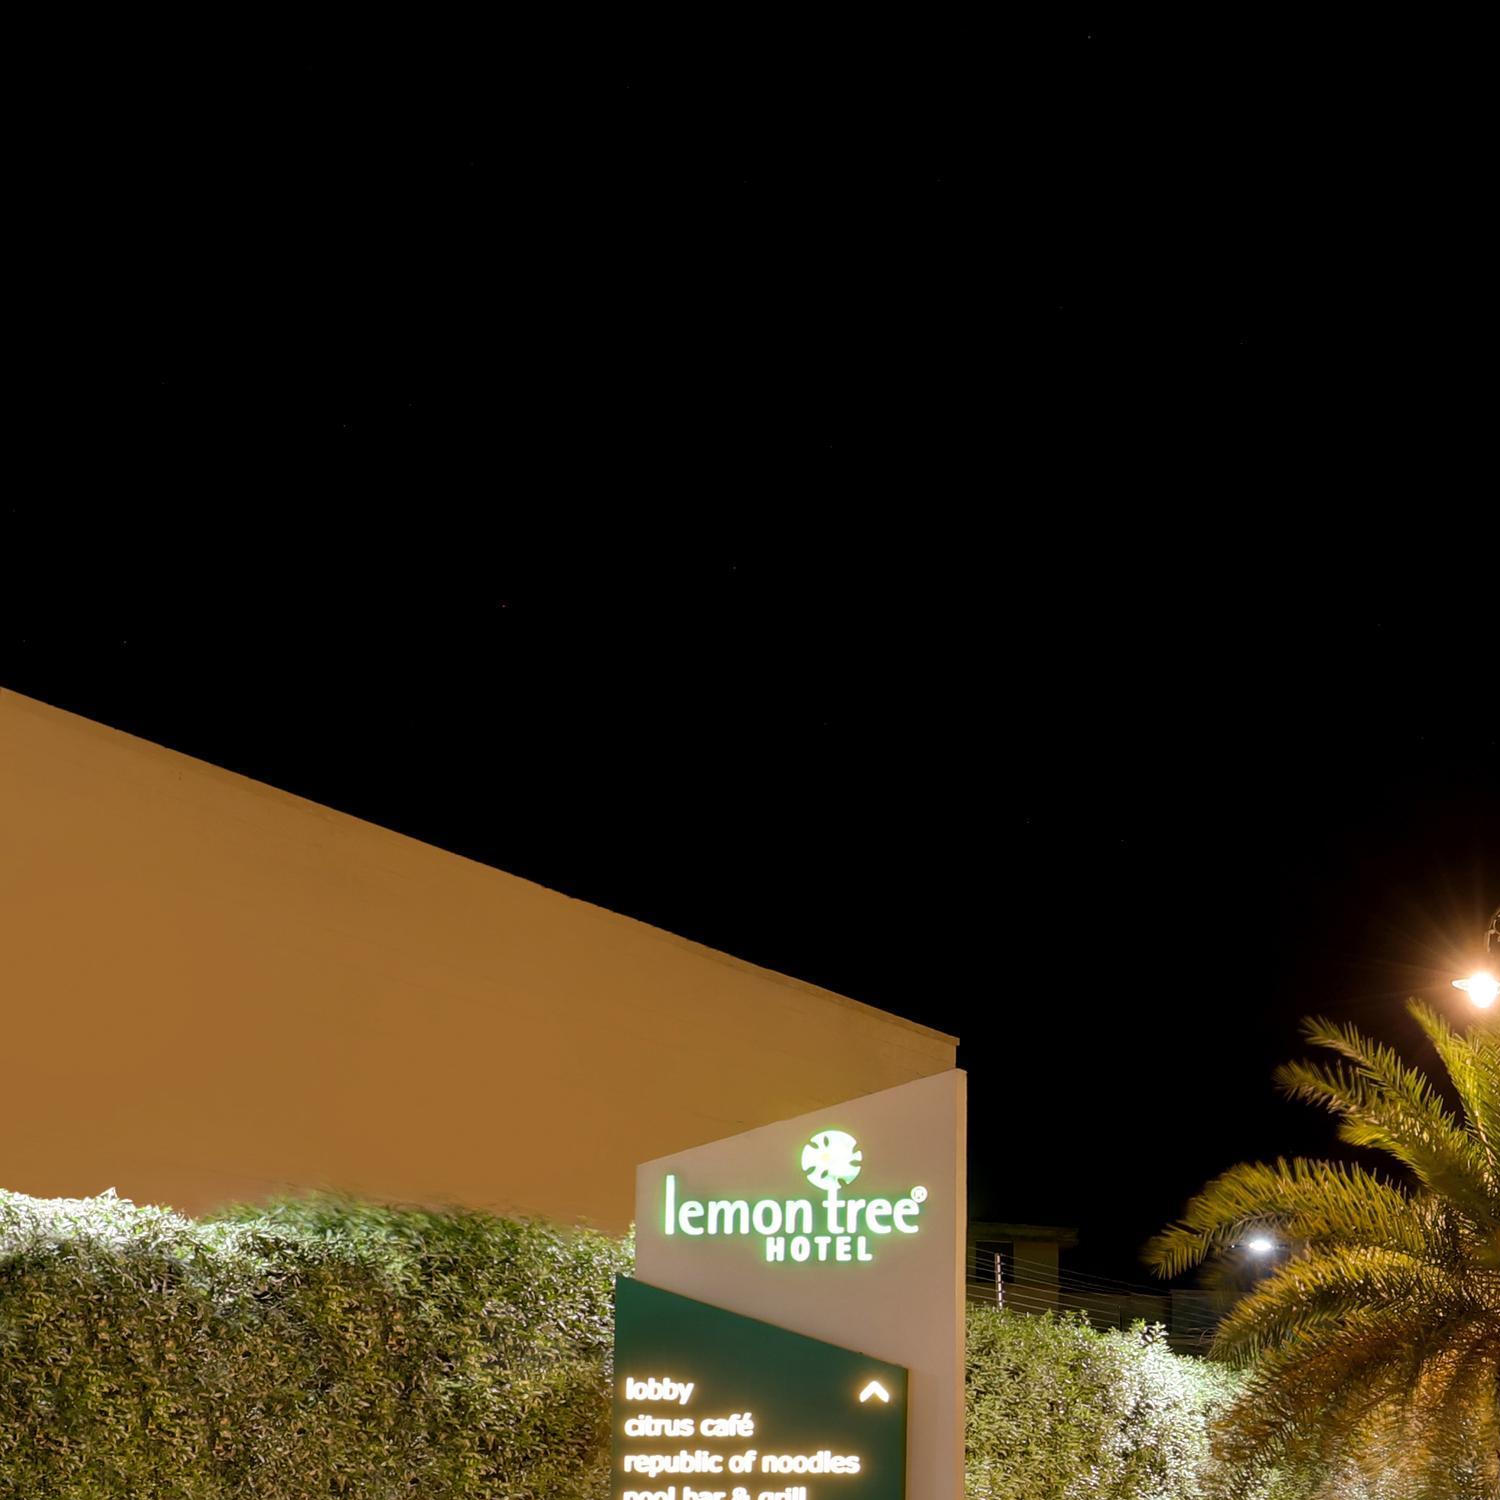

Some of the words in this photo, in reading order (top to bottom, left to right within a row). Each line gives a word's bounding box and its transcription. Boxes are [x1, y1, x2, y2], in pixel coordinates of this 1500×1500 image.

[664, 1174, 812, 1235] lemon
[765, 1236, 873, 1262] HOTEL
[625, 1377, 694, 1404] lobby
[624, 1415, 694, 1437] citrus
[700, 1412, 755, 1437] café
[623, 1451, 723, 1477] republic
[728, 1451, 757, 1474] of
[761, 1451, 861, 1474] noodles
